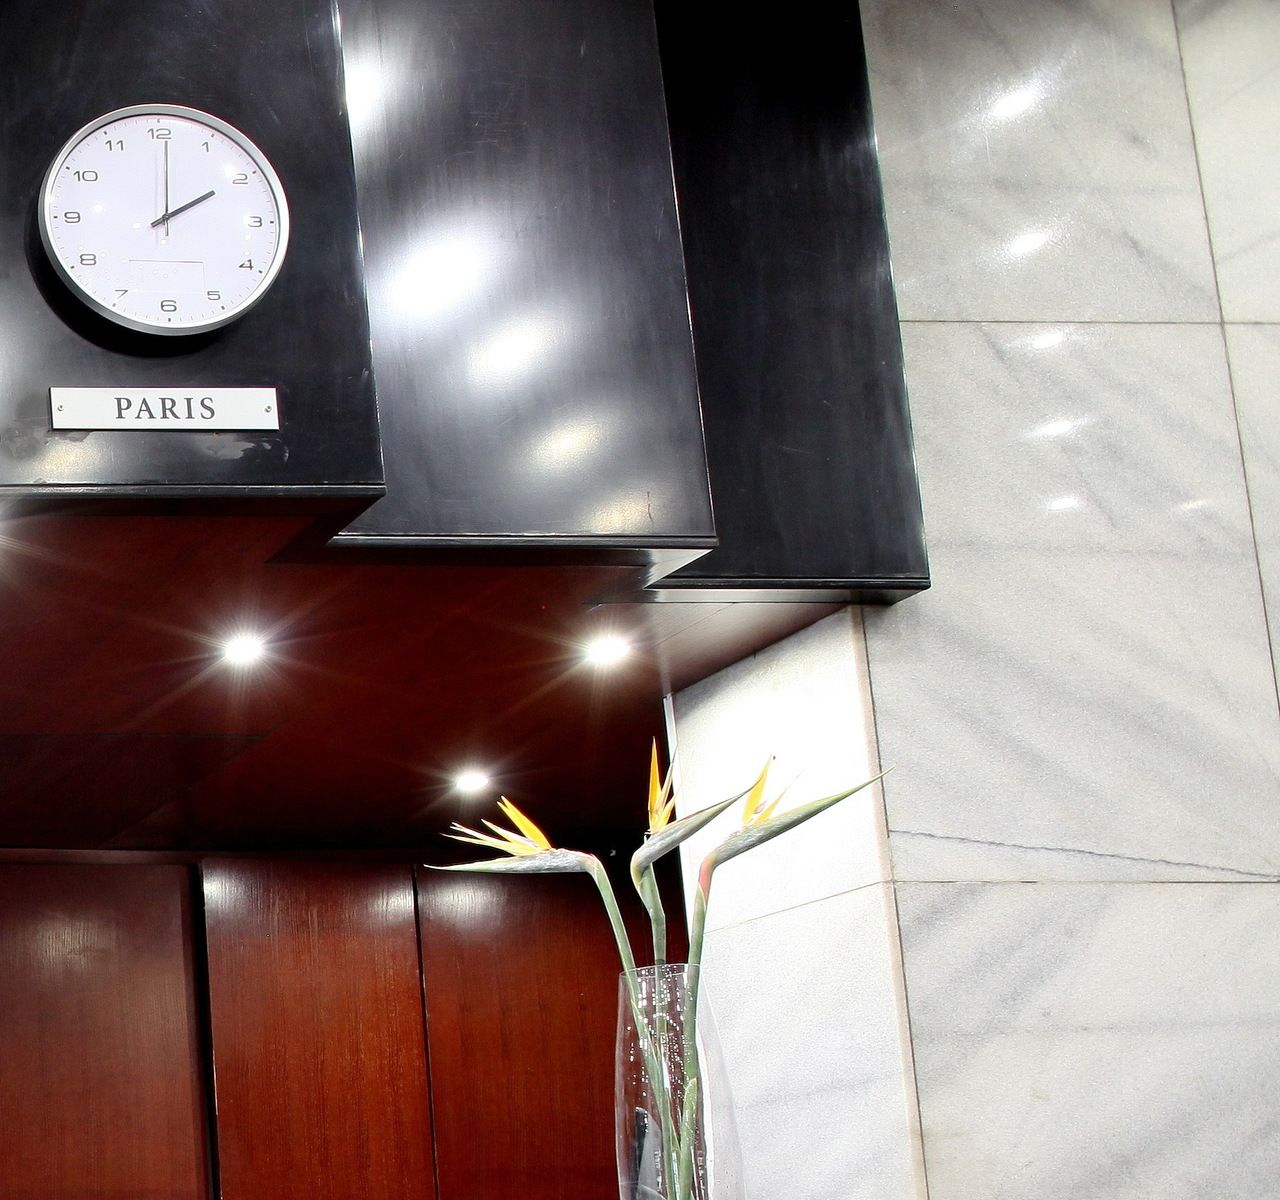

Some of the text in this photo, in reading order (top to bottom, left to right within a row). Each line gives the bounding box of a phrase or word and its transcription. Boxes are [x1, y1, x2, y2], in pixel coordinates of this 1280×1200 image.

[146, 127, 173, 140] 12
[104, 139, 125, 152] 11
[201, 141, 212, 153] 1
[72, 170, 99, 183] 10
[232, 173, 249, 185] 2
[63, 211, 82, 224] 9
[246, 215, 264, 228] 3
[78, 252, 98, 267] 8
[238, 258, 255, 272] 4
[114, 289, 129, 299] 7
[206, 290, 222, 302] 5
[160, 299, 178, 313] 6
[113, 396, 217, 420] PARIS
